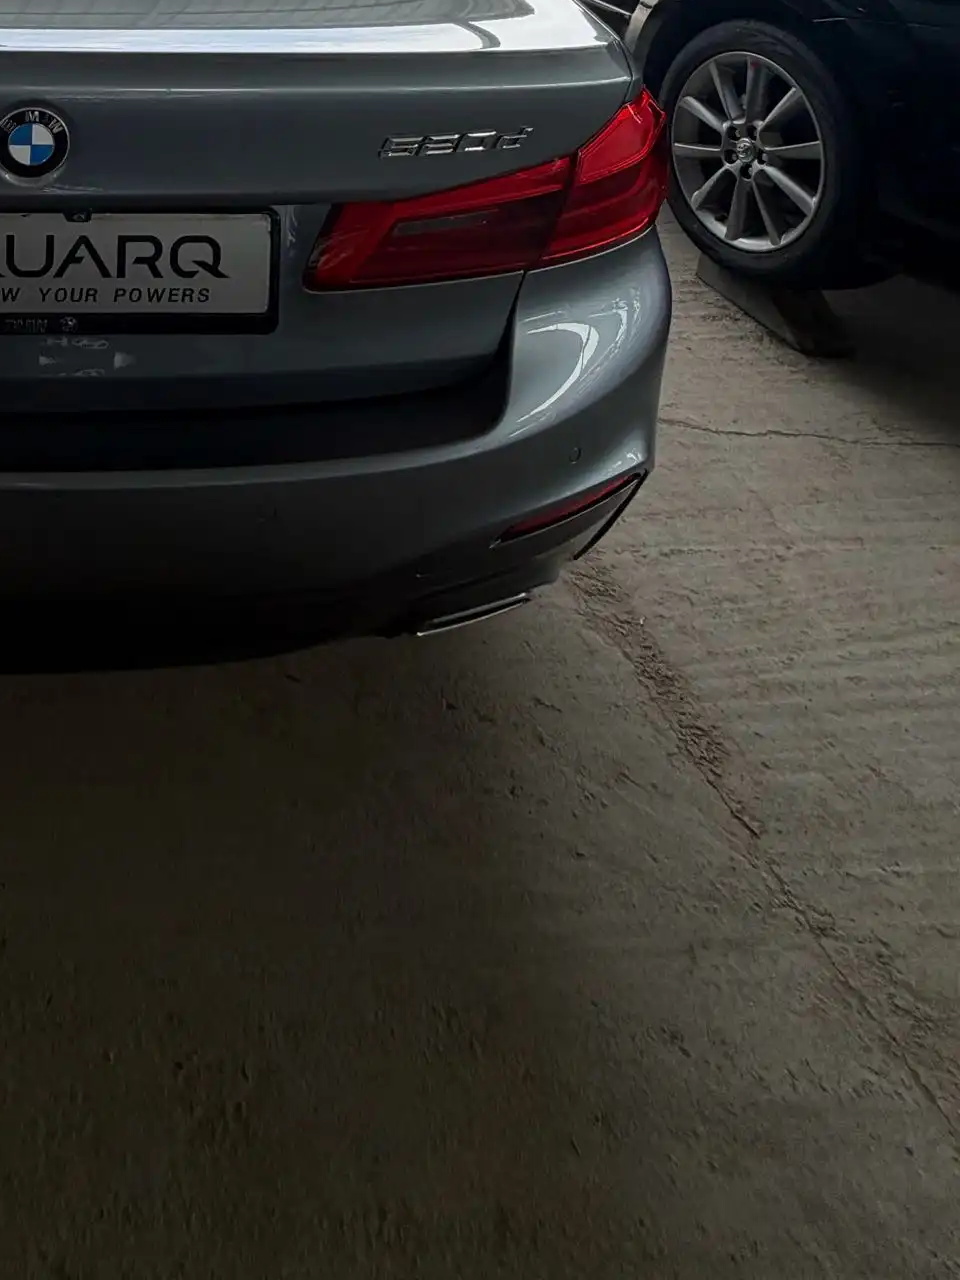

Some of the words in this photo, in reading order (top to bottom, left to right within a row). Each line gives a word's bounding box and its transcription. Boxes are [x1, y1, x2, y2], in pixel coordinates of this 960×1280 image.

[0, 111, 64, 134] BMW
[39, 287, 99, 303] YOUR
[113, 287, 211, 303] POWERS
